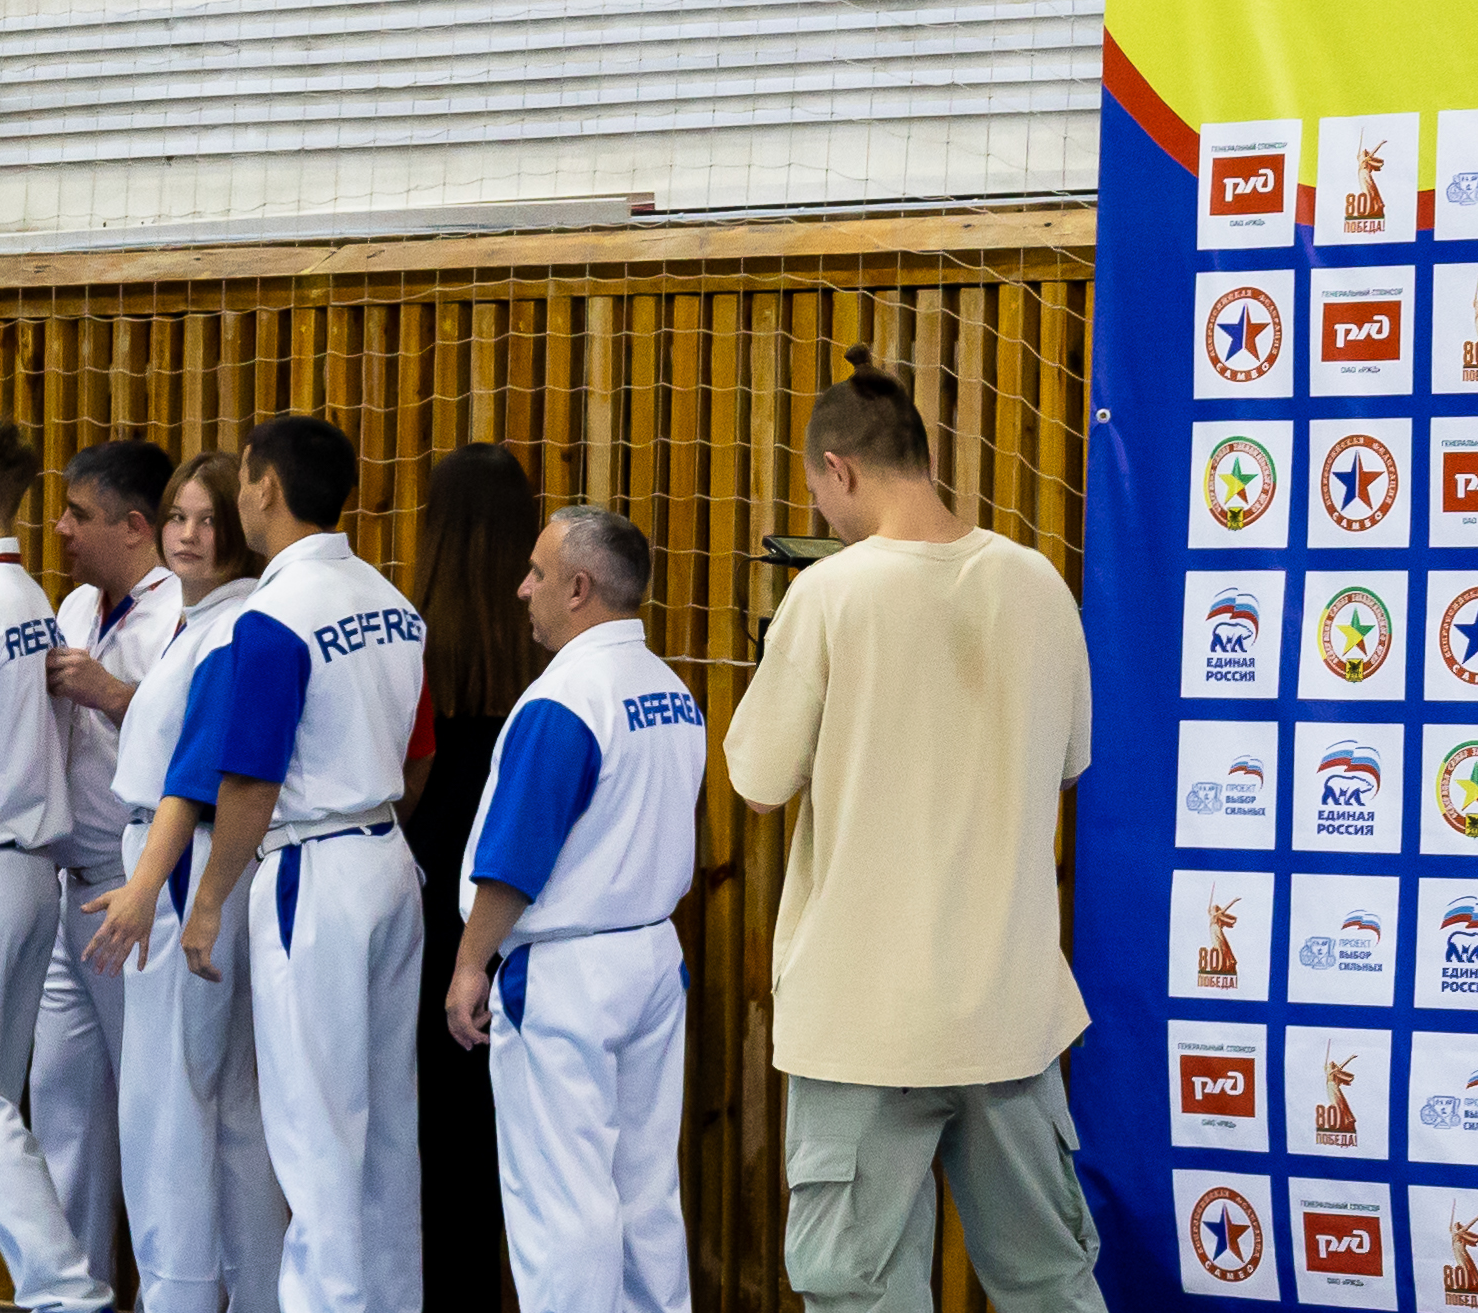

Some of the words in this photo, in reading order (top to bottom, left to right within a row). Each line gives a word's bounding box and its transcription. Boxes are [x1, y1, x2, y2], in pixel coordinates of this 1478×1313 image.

[1344, 218, 1385, 234] ПОБЕДА!
[1218, 359, 1270, 381] САМБО
[1333, 508, 1387, 529] САМБО
[1207, 657, 1255, 668] ЕДИНАЯ
[1206, 671, 1255, 681] РОССИЯ
[1318, 810, 1374, 822] ЕДИНАЯ
[1318, 823, 1374, 835] РОССИЯ
[1197, 973, 1238, 989] ПОБЕДА!
[1316, 1133, 1357, 1148] ПОБЕДА!
[1206, 1257, 1254, 1281] САМБО
